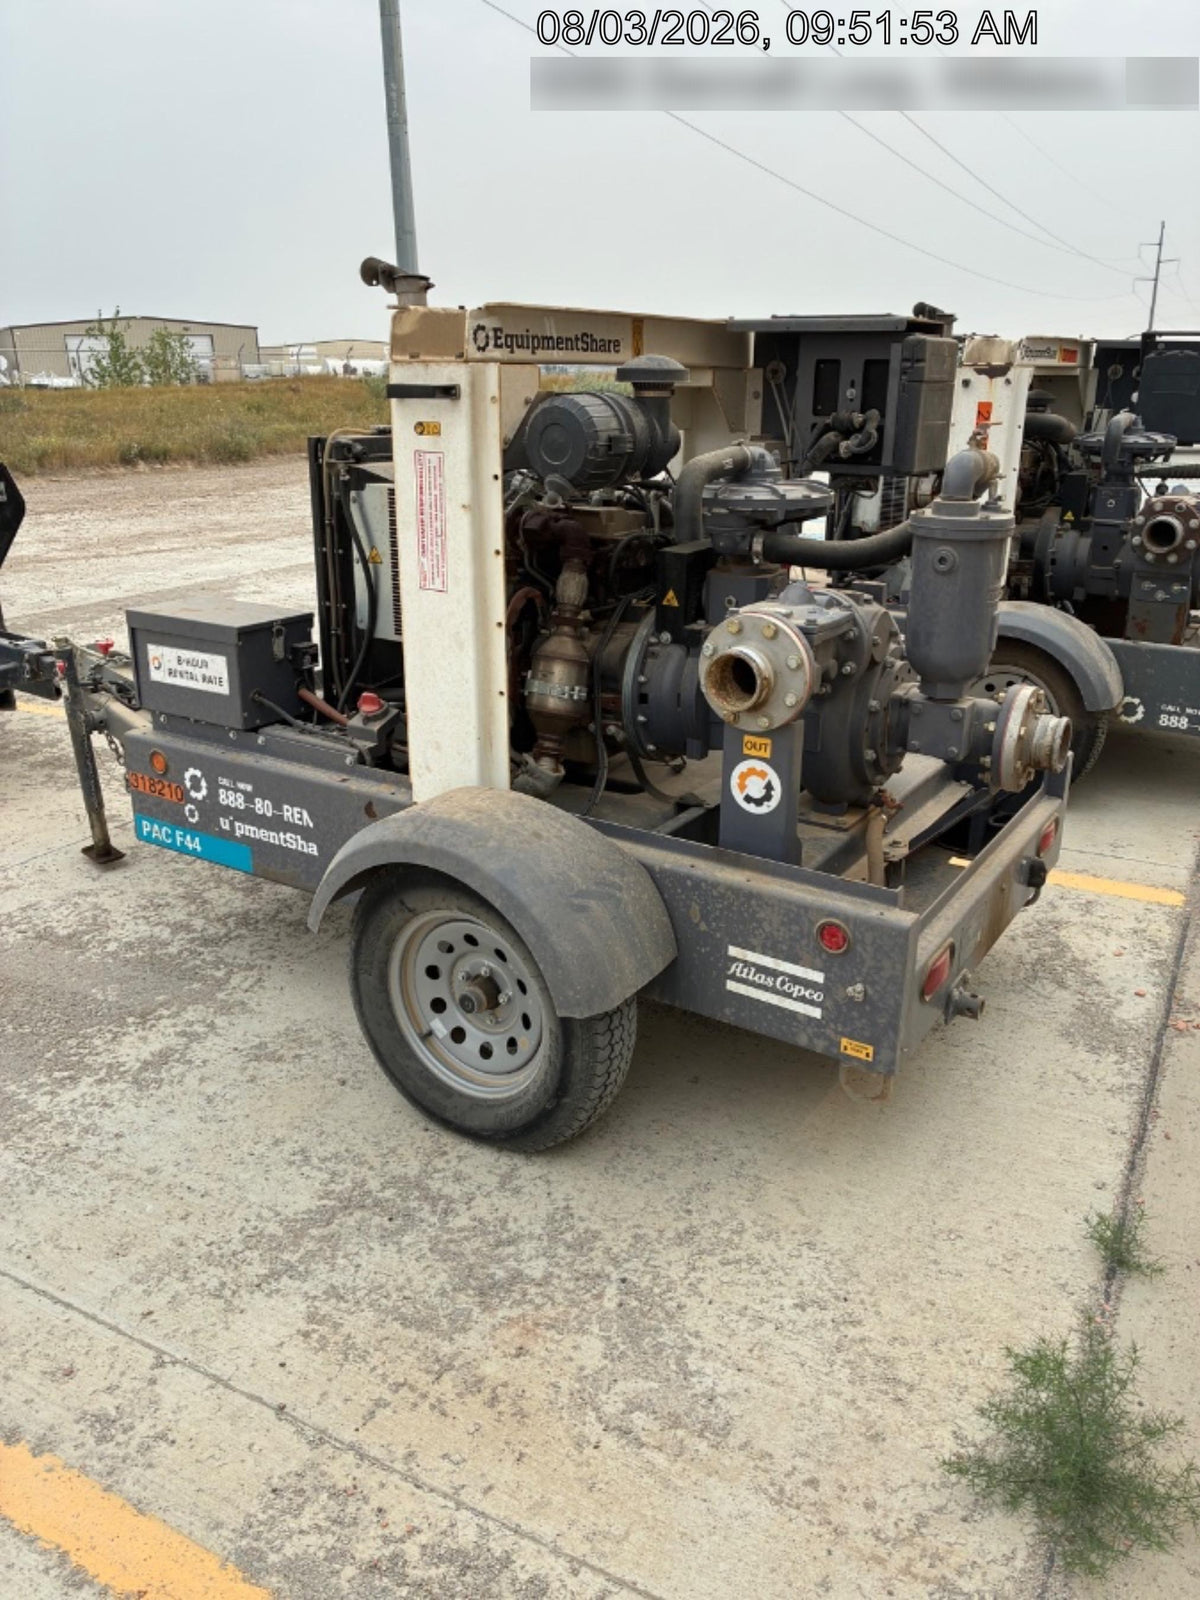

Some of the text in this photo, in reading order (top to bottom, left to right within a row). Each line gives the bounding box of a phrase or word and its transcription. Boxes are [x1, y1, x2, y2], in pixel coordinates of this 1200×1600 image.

[492, 327, 621, 354] EquipmentShare
[202, 673, 224, 687] RATE
[1159, 714, 1200, 731] 888-
[744, 740, 769, 753] OUT
[142, 820, 202, 852] PAC F44
[727, 961, 824, 1002] Atlas Copco
